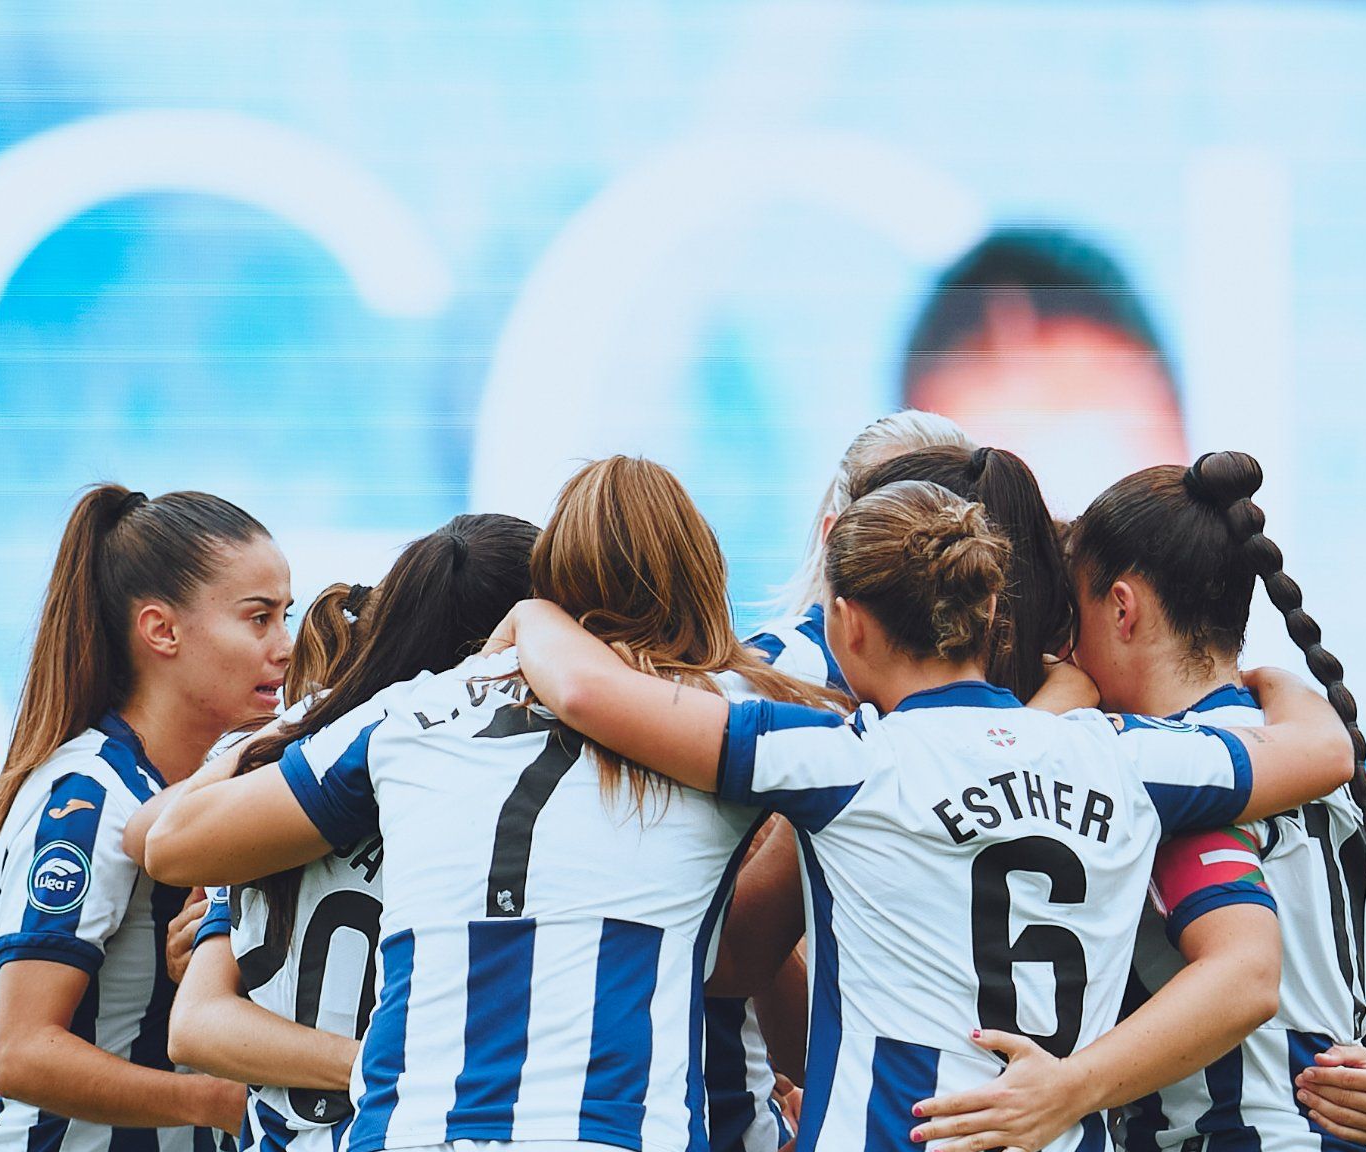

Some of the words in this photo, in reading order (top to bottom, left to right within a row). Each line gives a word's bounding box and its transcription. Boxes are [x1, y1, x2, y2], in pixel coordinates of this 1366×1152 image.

[471, 702, 587, 917] 7
[931, 770, 1115, 845] ESTHER
[65, 880, 77, 892] F
[971, 835, 1087, 1064] 6
